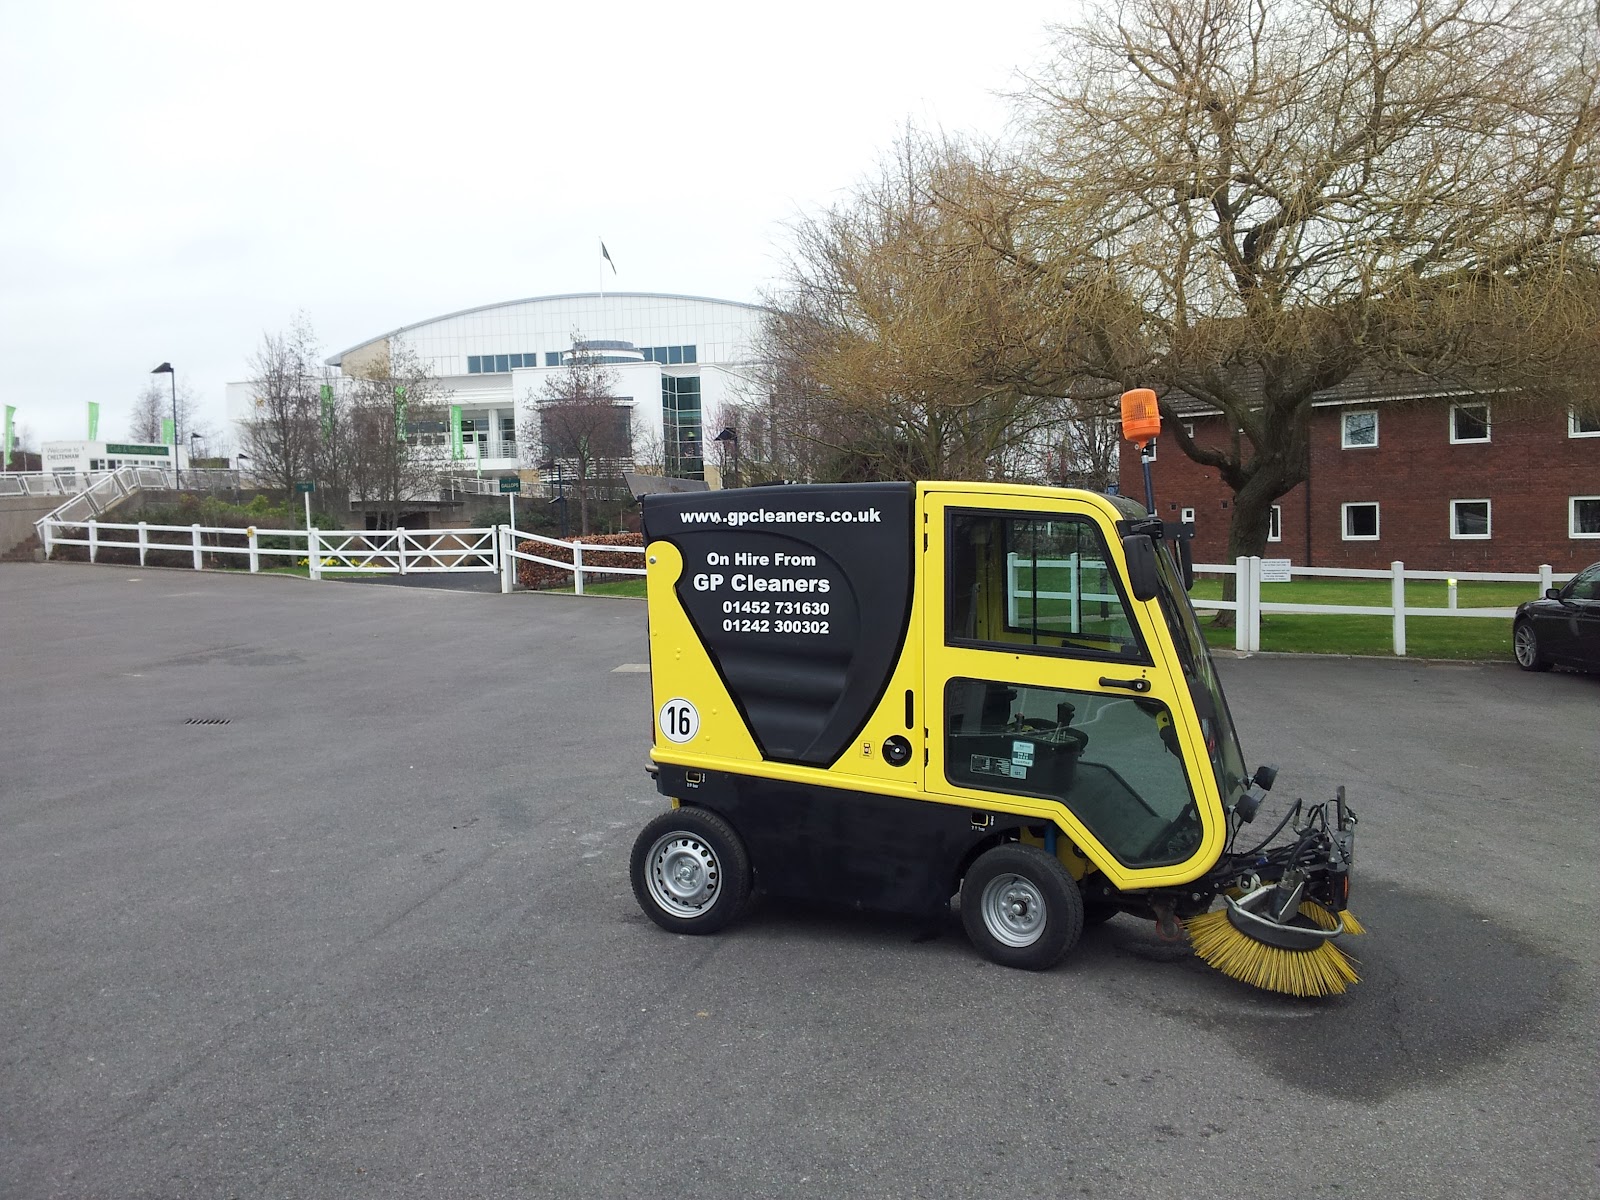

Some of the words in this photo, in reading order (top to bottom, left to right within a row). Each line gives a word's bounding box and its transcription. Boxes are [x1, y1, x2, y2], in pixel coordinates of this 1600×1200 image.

[47, 453, 79, 461] CHELTENHAM
[680, 508, 881, 526] www.gpcleaners.co.uk
[706, 552, 730, 566] On
[734, 552, 770, 566] Hire
[774, 552, 816, 567] From
[693, 574, 724, 592] GP
[731, 574, 831, 593] Cleaners
[722, 600, 771, 614] 01452
[774, 601, 830, 616] 731630
[722, 618, 770, 633] 01242
[773, 619, 830, 634] 300302
[667, 706, 690, 736] 16
